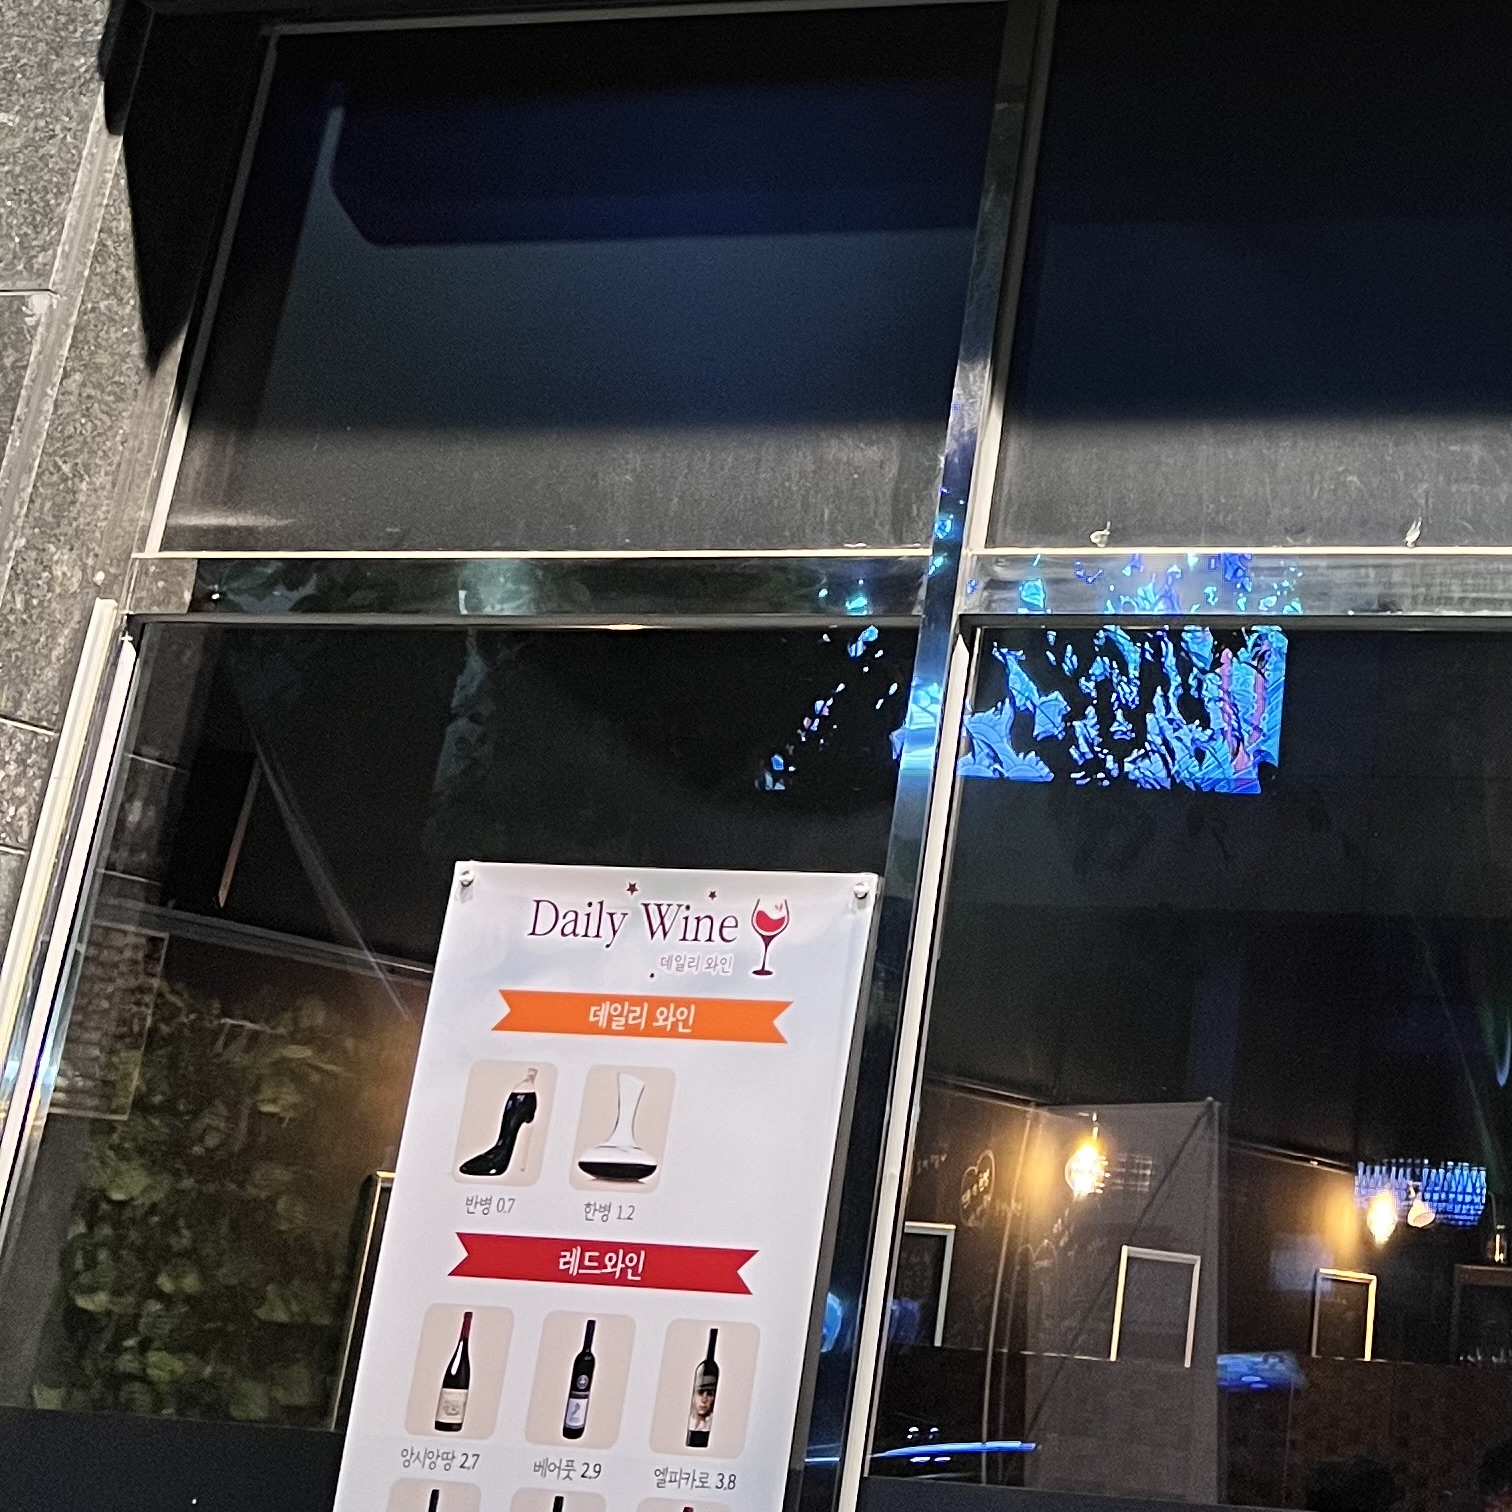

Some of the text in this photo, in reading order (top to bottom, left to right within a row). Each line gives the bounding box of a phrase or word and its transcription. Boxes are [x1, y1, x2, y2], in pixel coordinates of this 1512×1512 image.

[527, 899, 739, 949] Daily Wine
[660, 954, 733, 974] 데일리 와인
[588, 1001, 696, 1033] 데일리 와인
[465, 1195, 516, 1216] 반병 0.7
[584, 1201, 636, 1223] 한병 1.2
[459, 1453, 481, 1471] 2.7
[532, 1457, 603, 1481] 베어풋 2.9
[653, 1466, 738, 1491] 엘피카로 3.8
